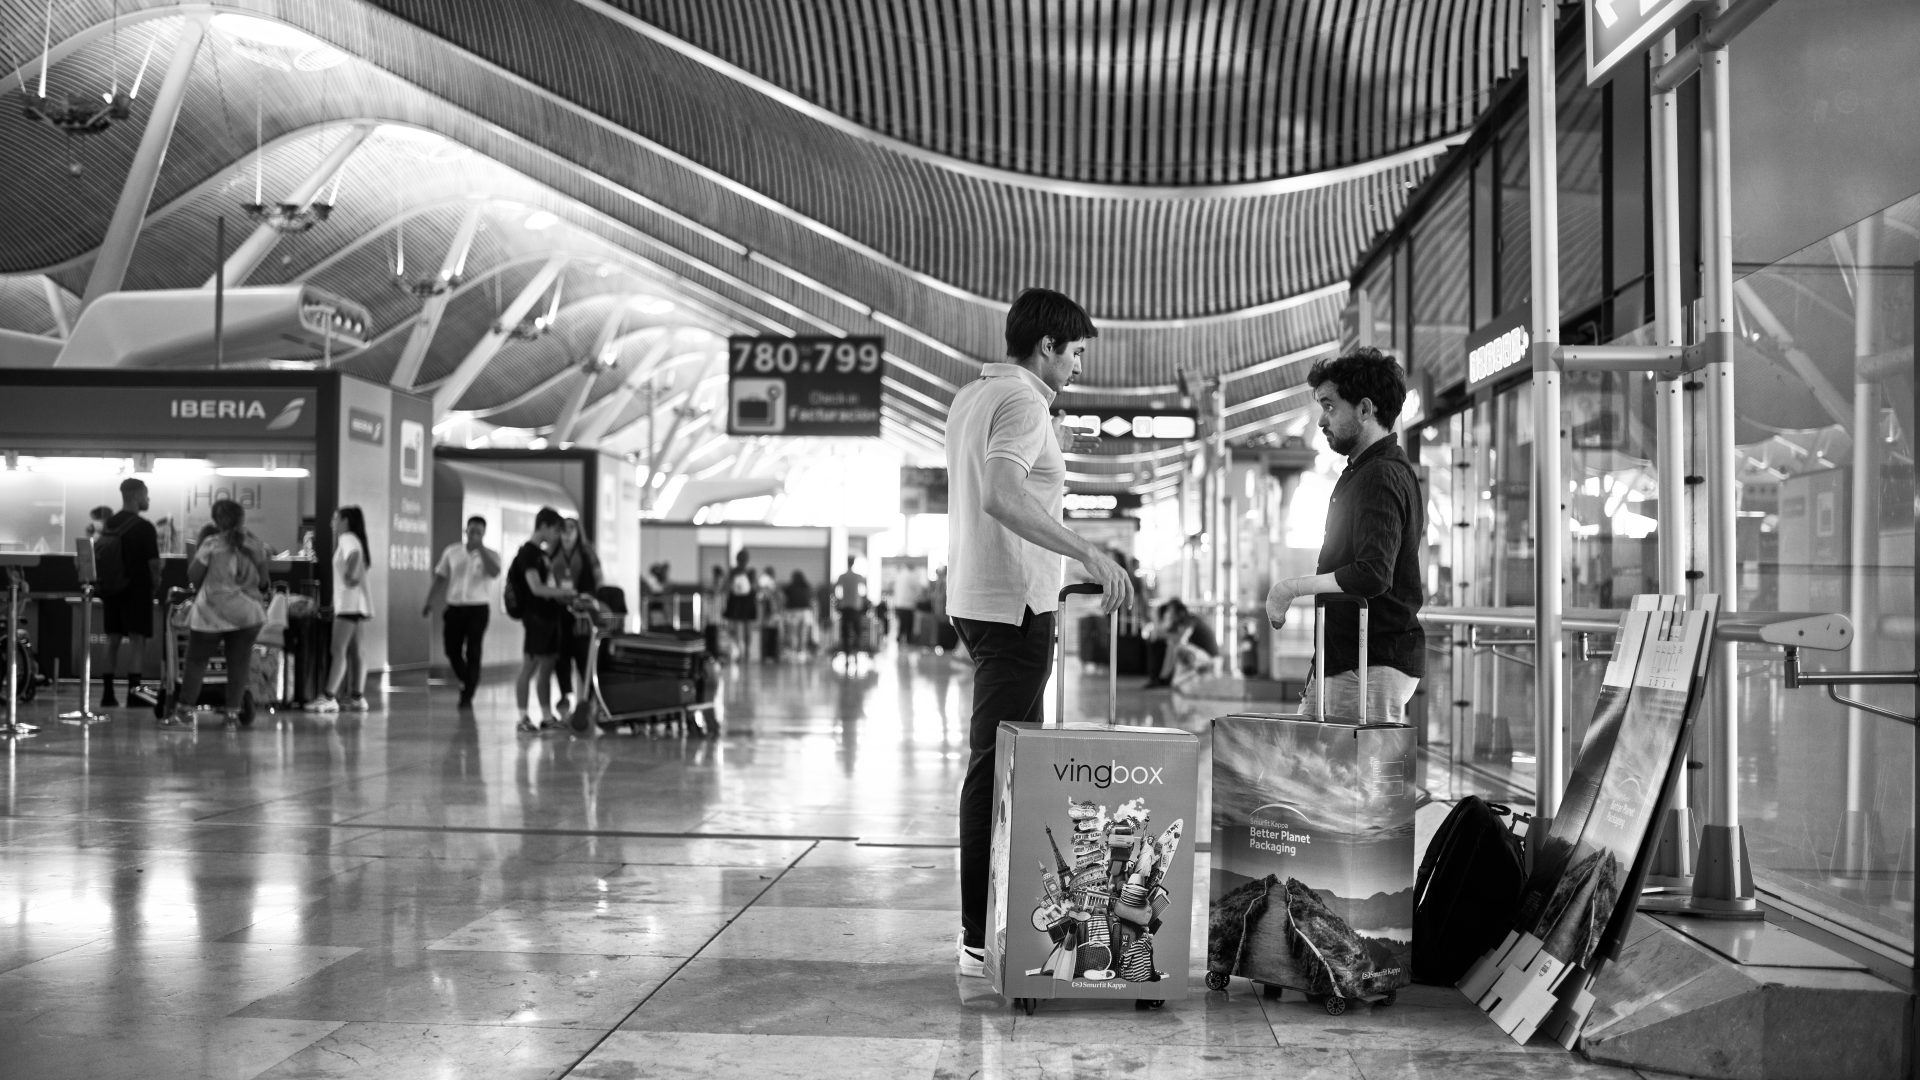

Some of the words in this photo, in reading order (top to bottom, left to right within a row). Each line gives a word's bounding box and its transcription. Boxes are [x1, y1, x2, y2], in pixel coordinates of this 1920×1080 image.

[171, 399, 266, 419] IBERIA
[1053, 758, 1164, 789] vingbox
[1250, 827, 1280, 840] Better
[1281, 830, 1311, 844] Planet
[1249, 839, 1296, 856] Packaging
[1107, 982, 1127, 990] Kappa
